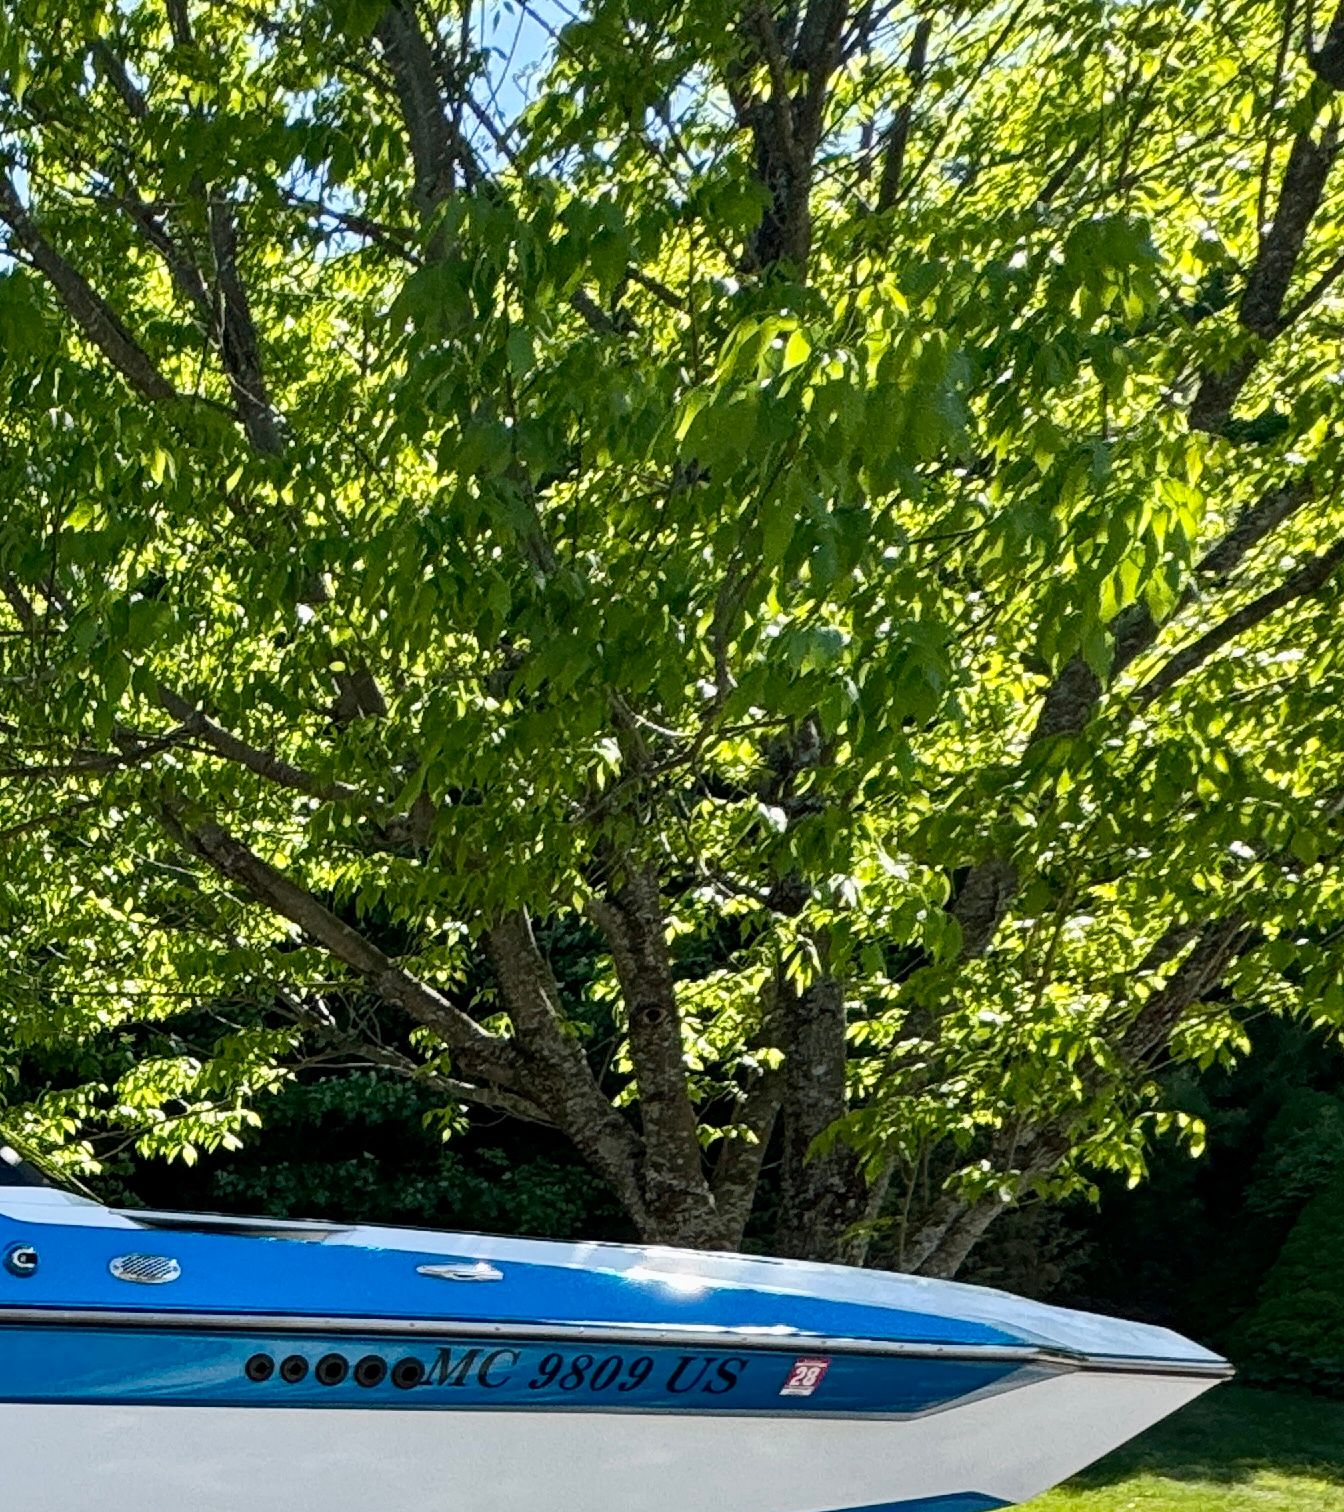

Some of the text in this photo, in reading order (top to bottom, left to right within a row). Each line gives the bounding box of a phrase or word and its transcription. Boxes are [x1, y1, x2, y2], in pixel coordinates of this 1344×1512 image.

[423, 1346, 748, 1395] MC 9809 US
[789, 1366, 821, 1386] 28
